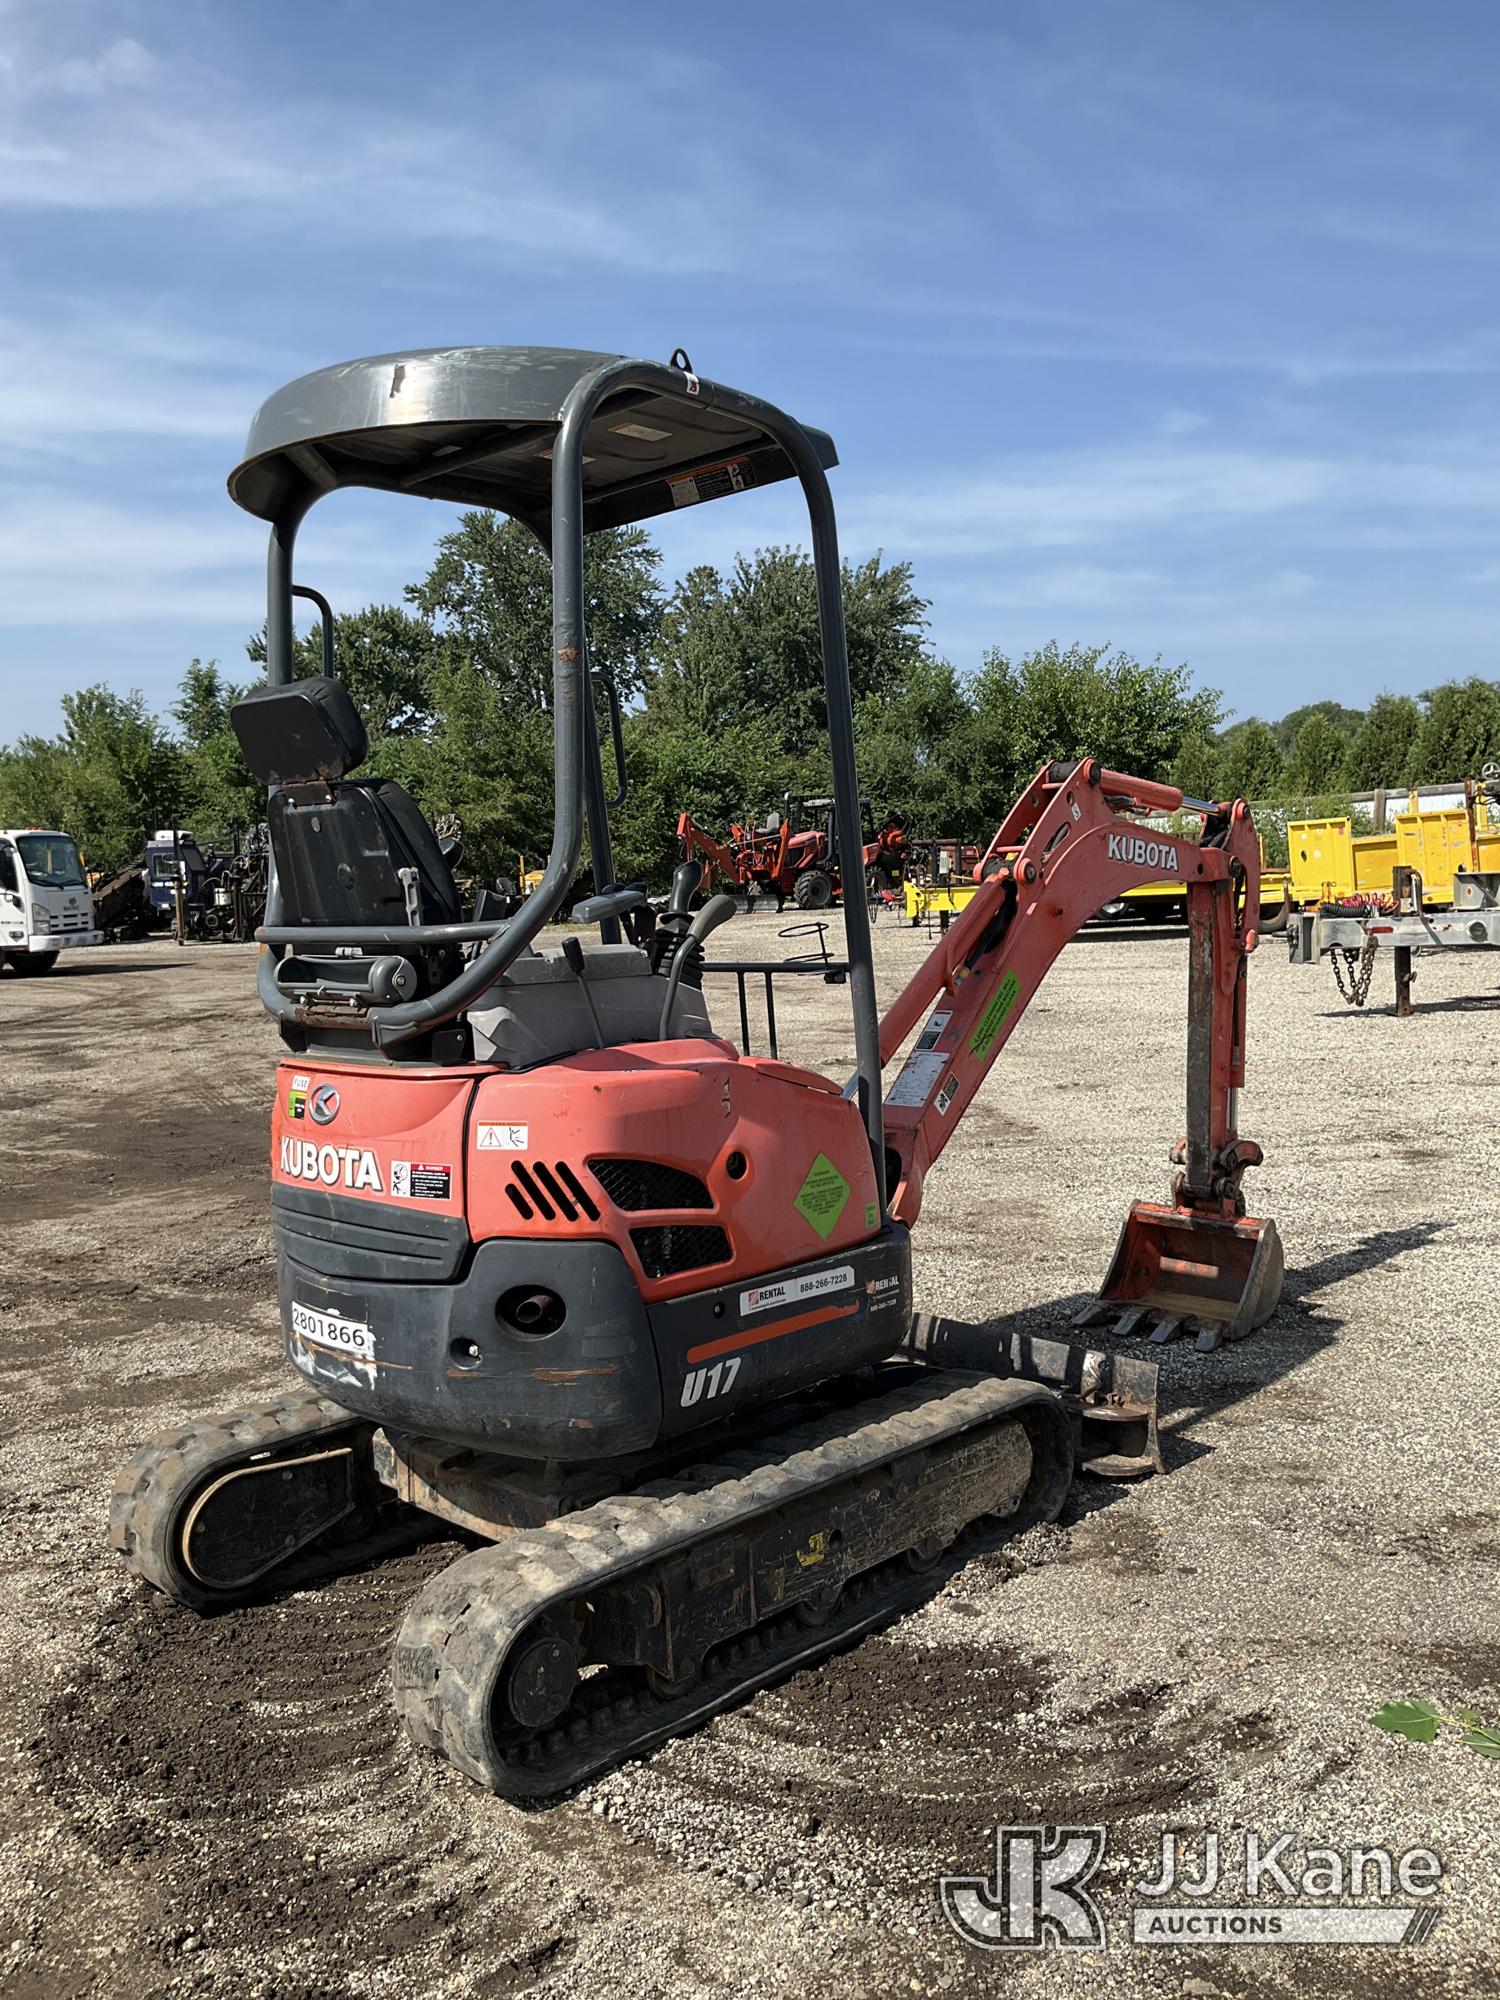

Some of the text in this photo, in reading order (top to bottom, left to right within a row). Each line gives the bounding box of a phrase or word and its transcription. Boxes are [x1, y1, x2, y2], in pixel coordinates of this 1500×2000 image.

[1107, 833, 1180, 872] KUBOTA
[280, 1134, 383, 1192] KUBOTA
[759, 1273, 848, 1301] RENTAL 888-266-7228
[293, 1308, 365, 1347] 2801866
[680, 1356, 742, 1408] U17
